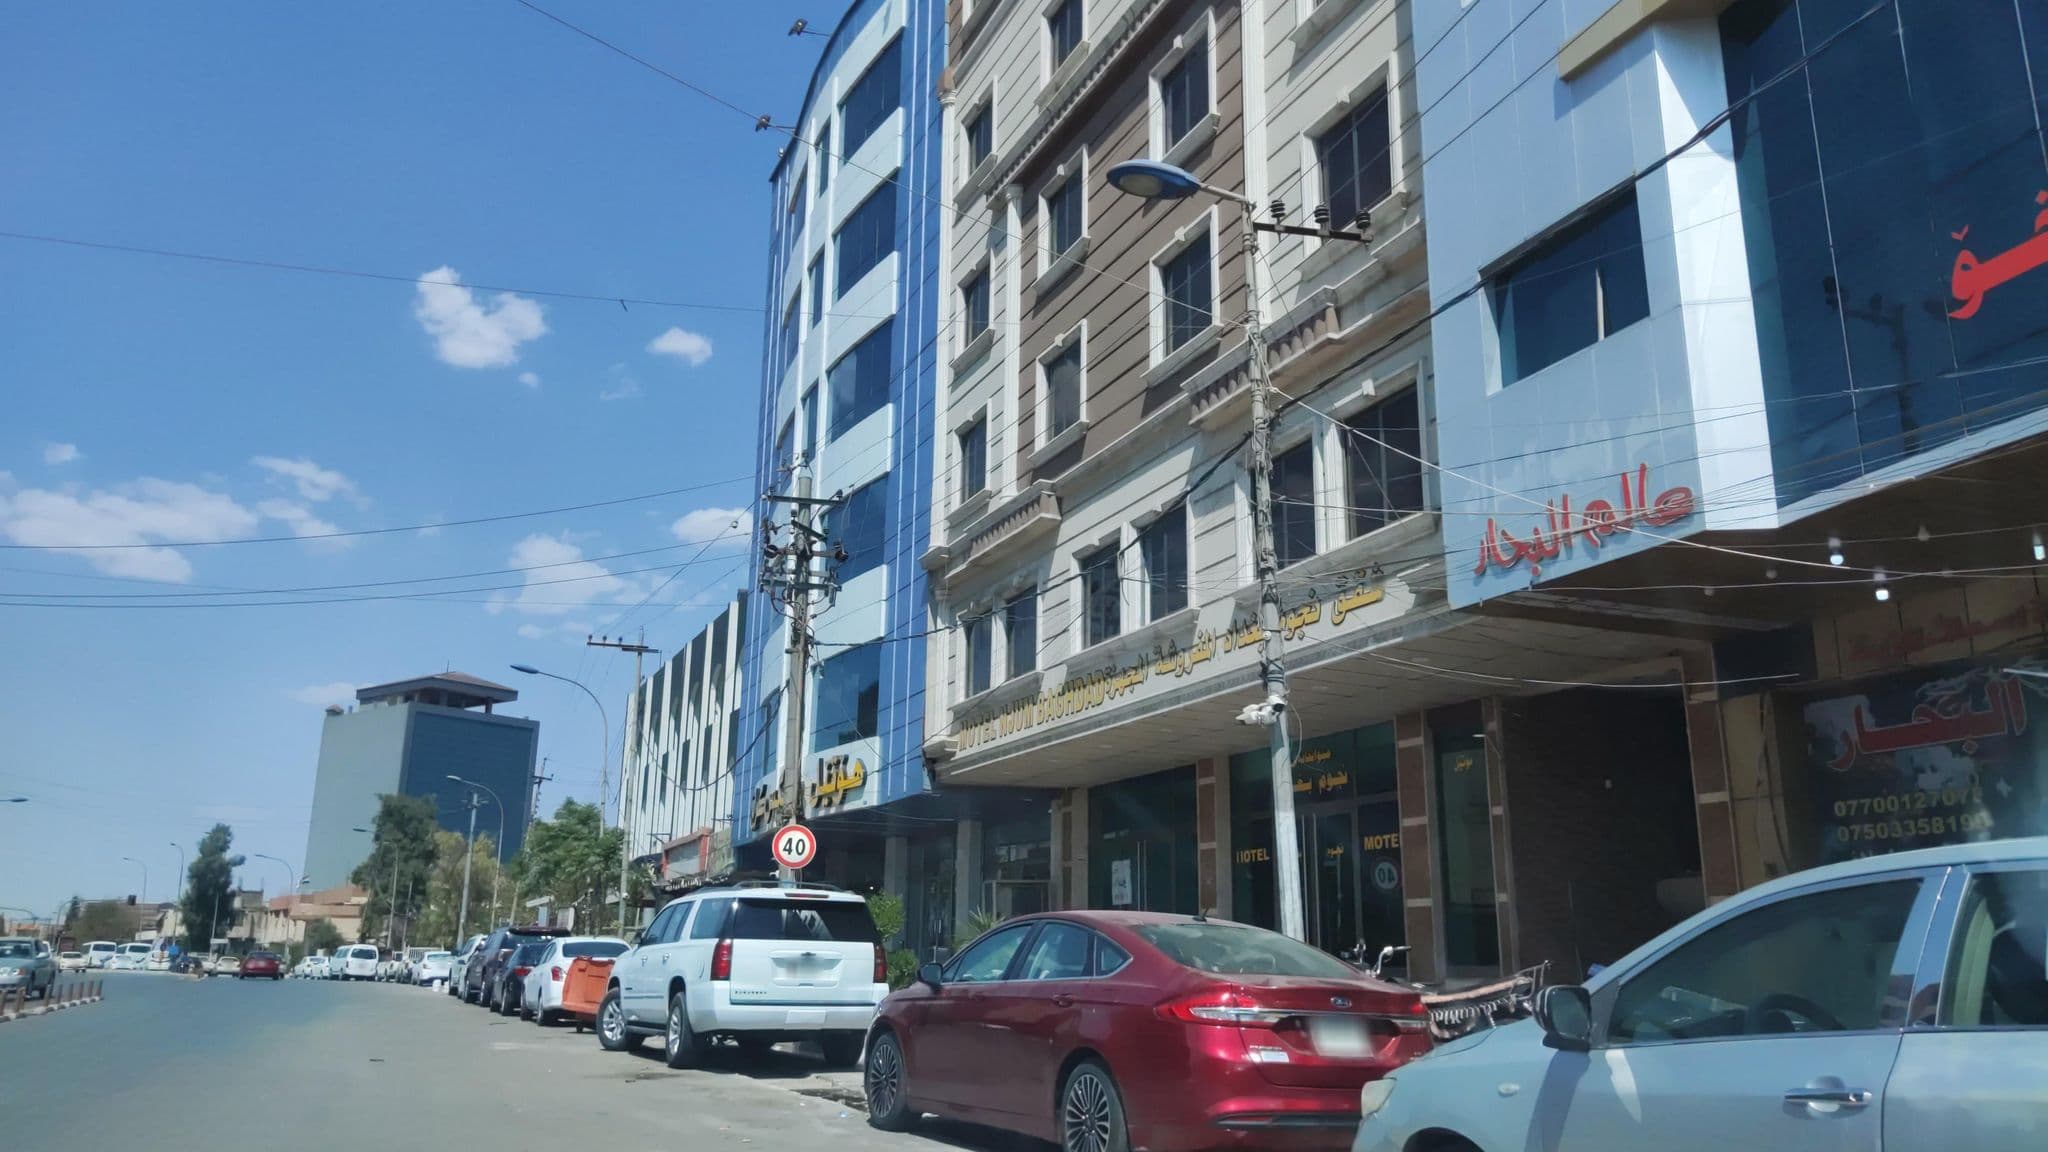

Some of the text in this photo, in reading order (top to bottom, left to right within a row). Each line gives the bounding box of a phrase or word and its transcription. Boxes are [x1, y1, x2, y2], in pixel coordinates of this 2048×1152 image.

[1473, 463, 1695, 577] عالم البحار
[1036, 669, 1105, 725] BAGHDAD
[782, 837, 806, 856] 40
[1363, 833, 1400, 851] MOTE
